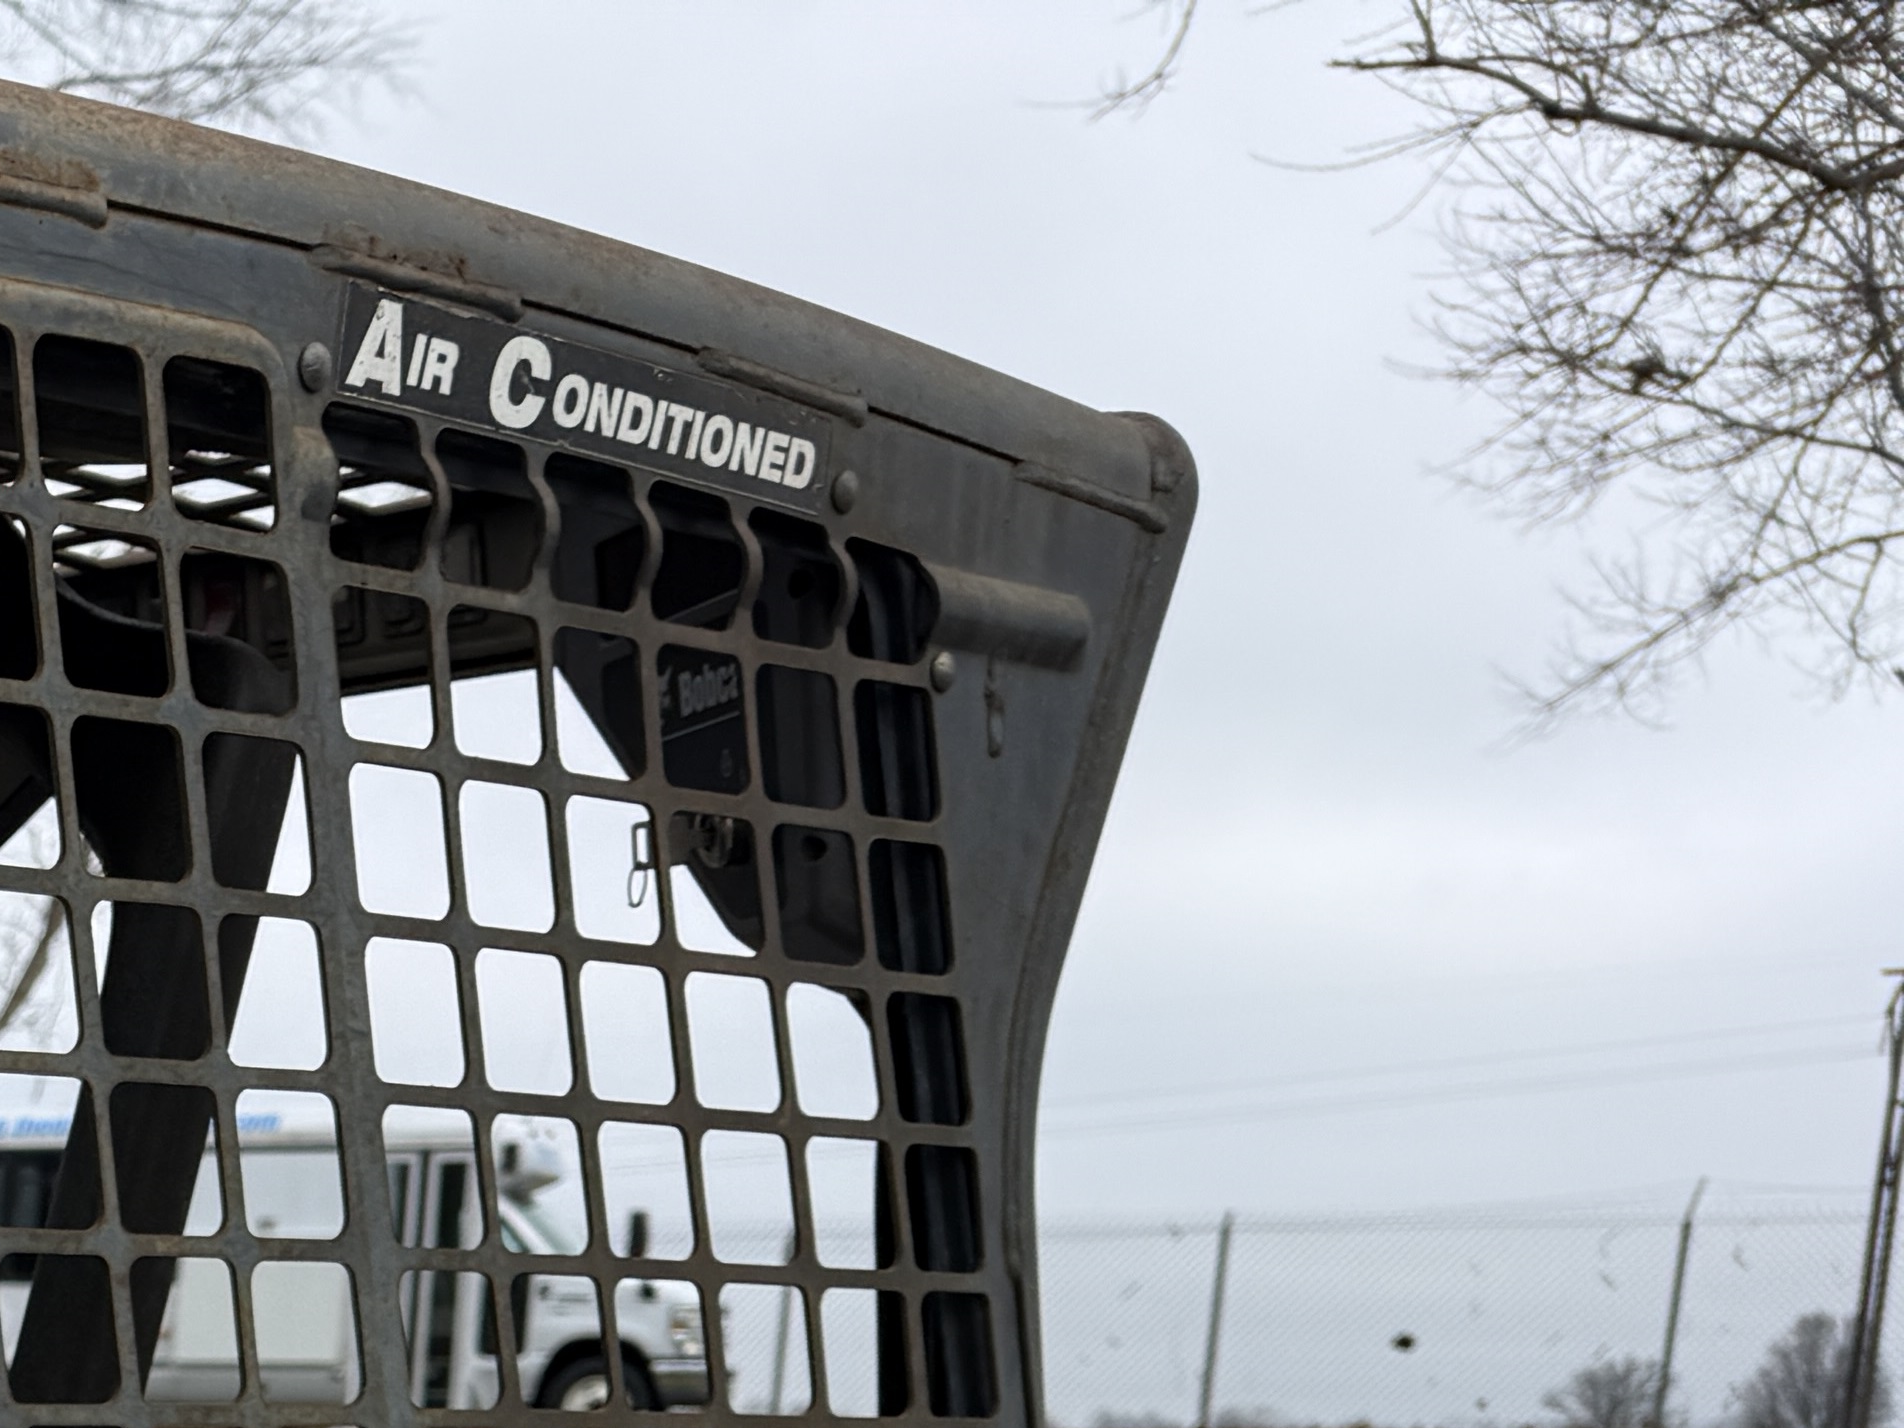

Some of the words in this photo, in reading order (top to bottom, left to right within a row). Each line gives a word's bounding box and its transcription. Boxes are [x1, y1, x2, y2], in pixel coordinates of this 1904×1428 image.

[345, 298, 460, 396] AIR
[490, 335, 816, 490] CONDITIONED
[678, 664, 739, 717] Bobca
